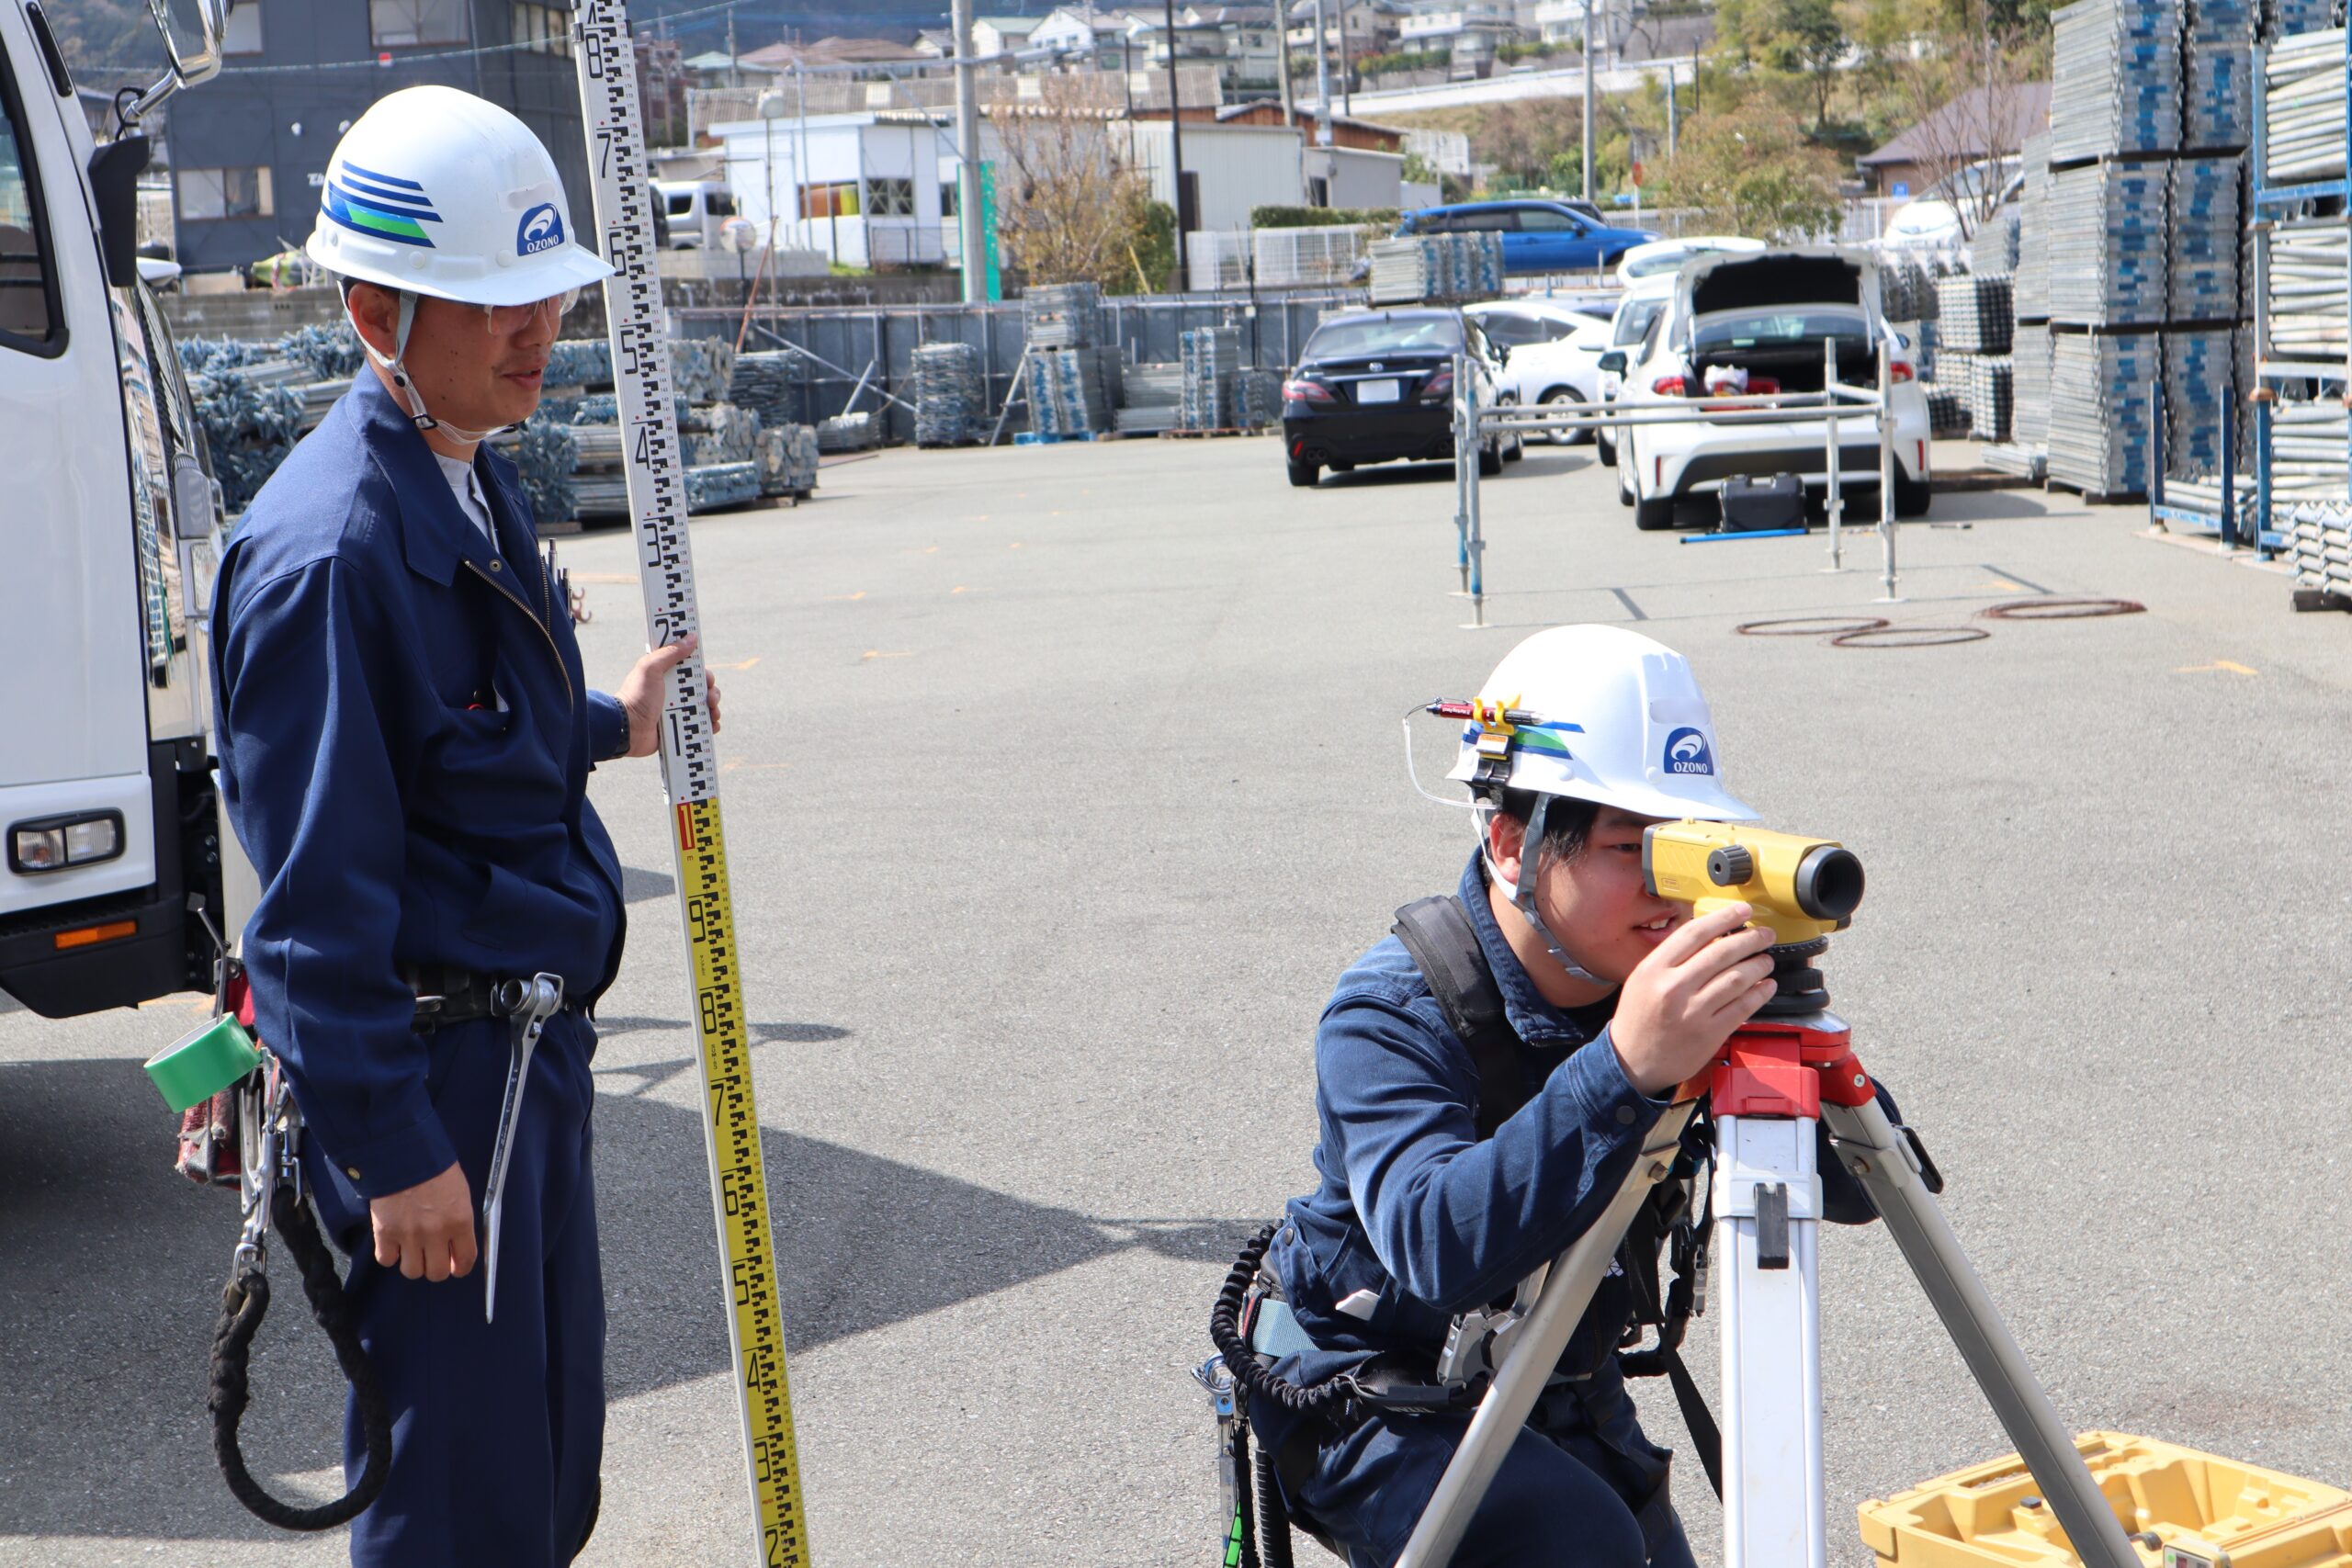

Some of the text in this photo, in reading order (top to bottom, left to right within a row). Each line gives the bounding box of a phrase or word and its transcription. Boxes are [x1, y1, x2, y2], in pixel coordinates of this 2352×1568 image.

[586, 33, 603, 78] 8
[597, 133, 611, 178] 7
[527, 235, 559, 253] OZONO
[609, 232, 626, 276] 6
[620, 330, 638, 374] 5
[635, 426, 650, 470] 4
[643, 523, 661, 567] 3
[670, 713, 680, 756] 1
[1674, 762, 1708, 773] OZONO
[681, 805, 692, 847] 1
[689, 900, 706, 943] 9
[700, 992, 717, 1034] 8
[711, 1083, 724, 1126] 7
[722, 1174, 739, 1216] 6
[733, 1264, 749, 1306] 5
[747, 1352, 760, 1392] 4
[754, 1441, 771, 1483] 3
[765, 1529, 781, 1568] 2
